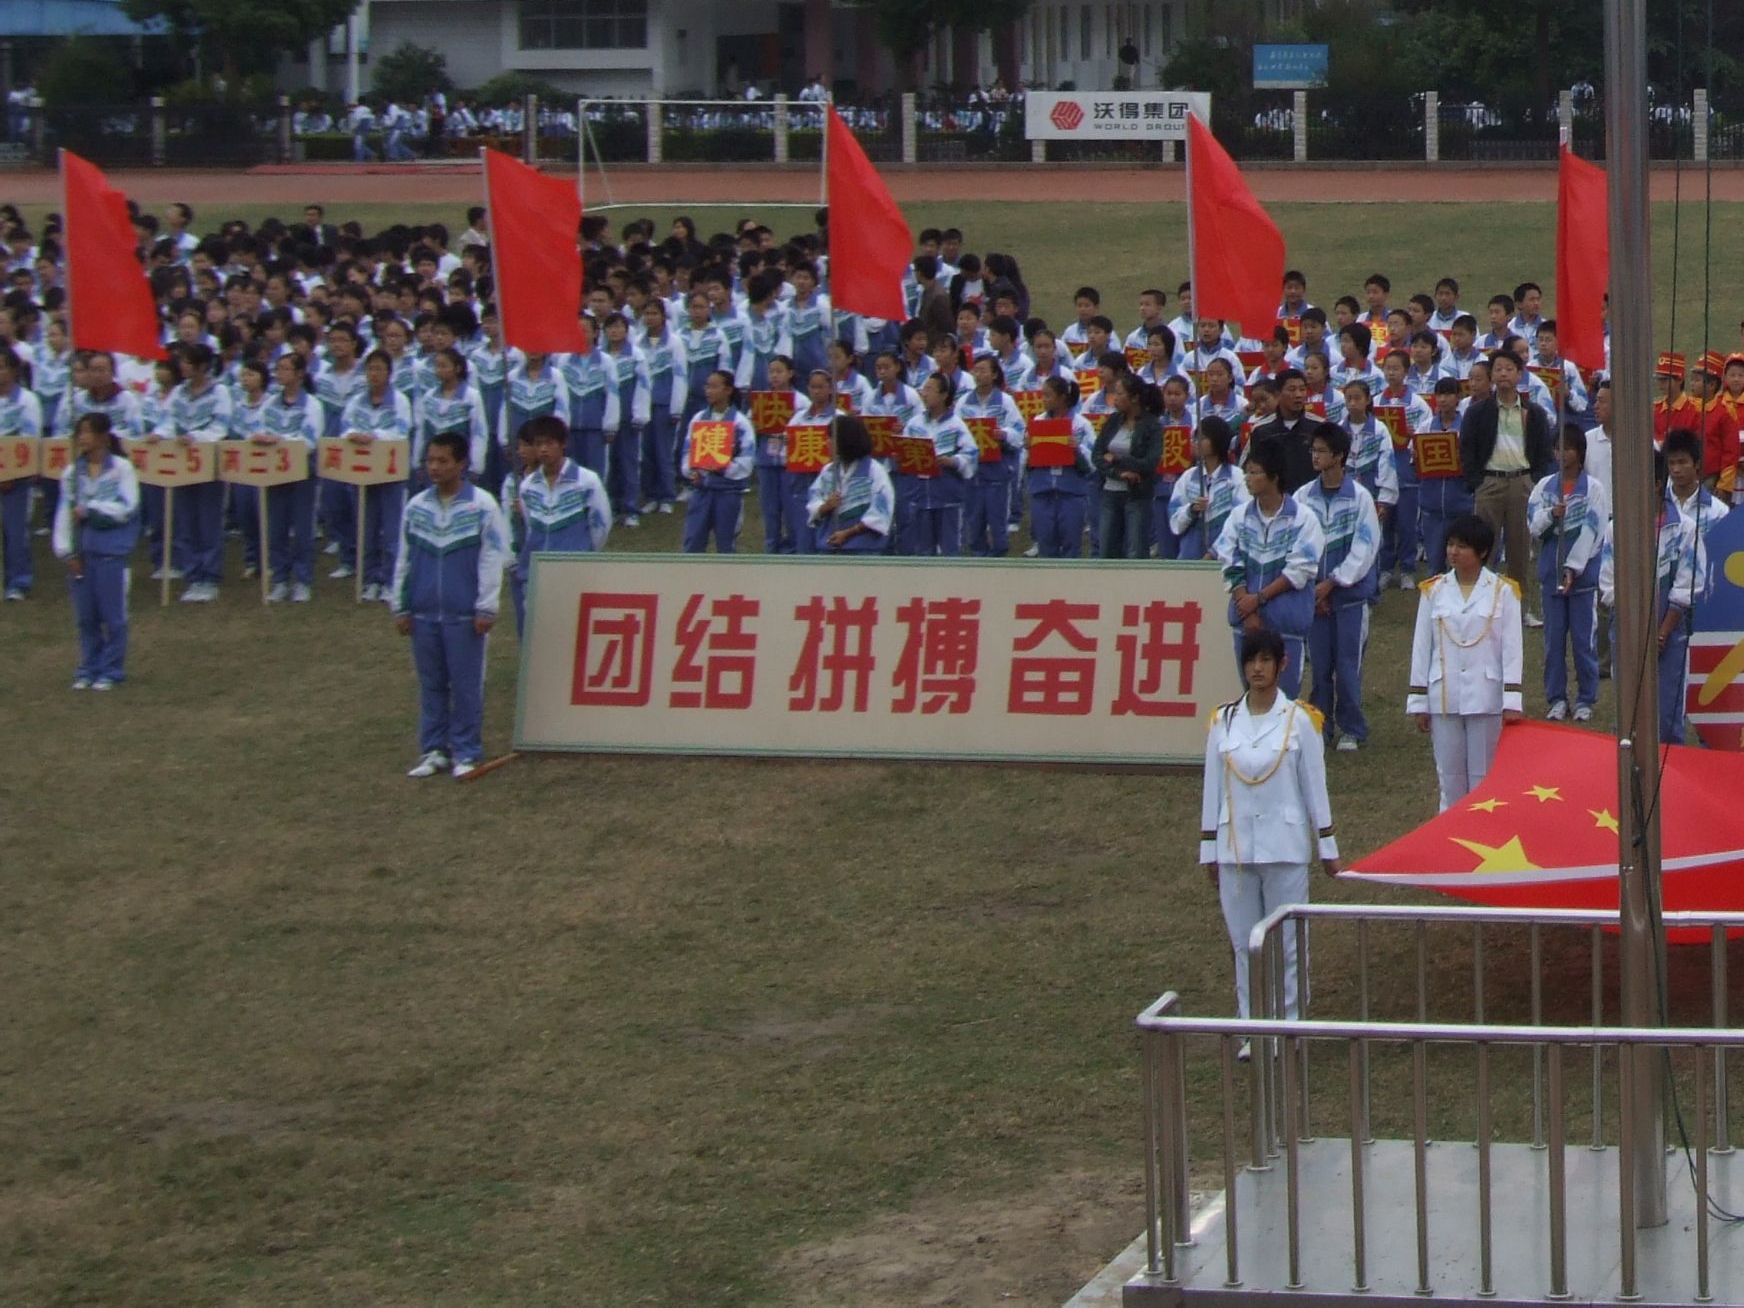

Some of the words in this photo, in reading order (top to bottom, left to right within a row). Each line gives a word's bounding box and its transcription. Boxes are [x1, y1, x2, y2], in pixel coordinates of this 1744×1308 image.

[1094, 102, 1188, 119] 沃得集团
[1094, 123, 1138, 131] WORLD
[692, 424, 731, 465] 健
[789, 427, 832, 467] 康
[901, 440, 936, 472] 第
[1031, 436, 1069, 446] 一
[1160, 429, 1192, 468] 段
[1421, 433, 1458, 474] 国
[570, 592, 1203, 718] 团结拼搏奋进
